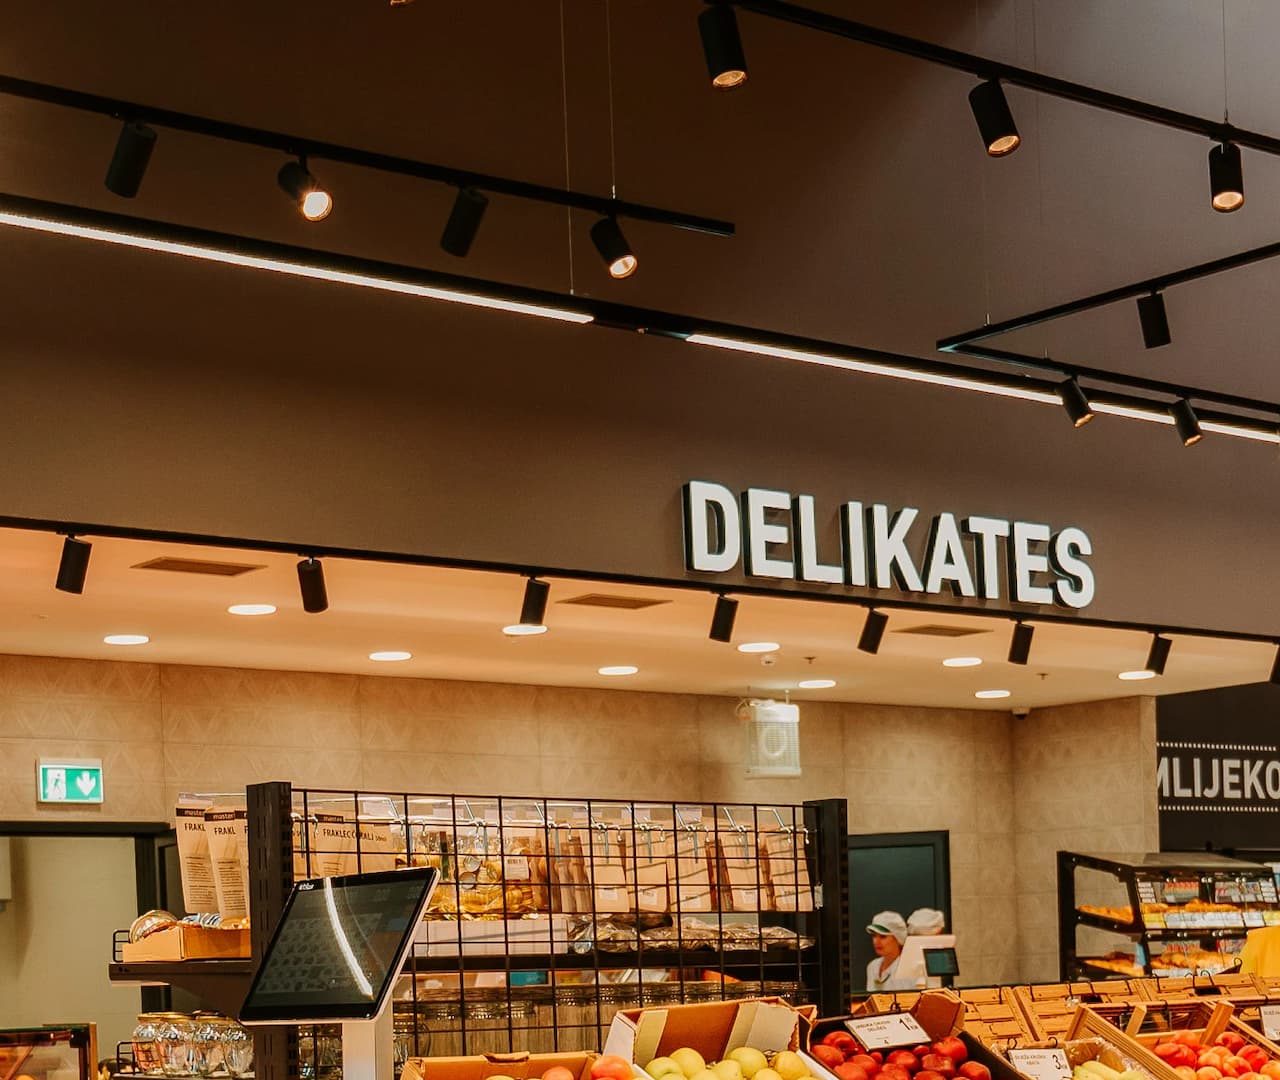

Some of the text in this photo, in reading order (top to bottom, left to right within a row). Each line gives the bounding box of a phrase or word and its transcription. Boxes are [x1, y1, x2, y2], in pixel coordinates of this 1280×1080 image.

[686, 480, 1096, 609] DELIKATES
[899, 1018, 911, 1031] 1
[1052, 1054, 1061, 1070] 3
